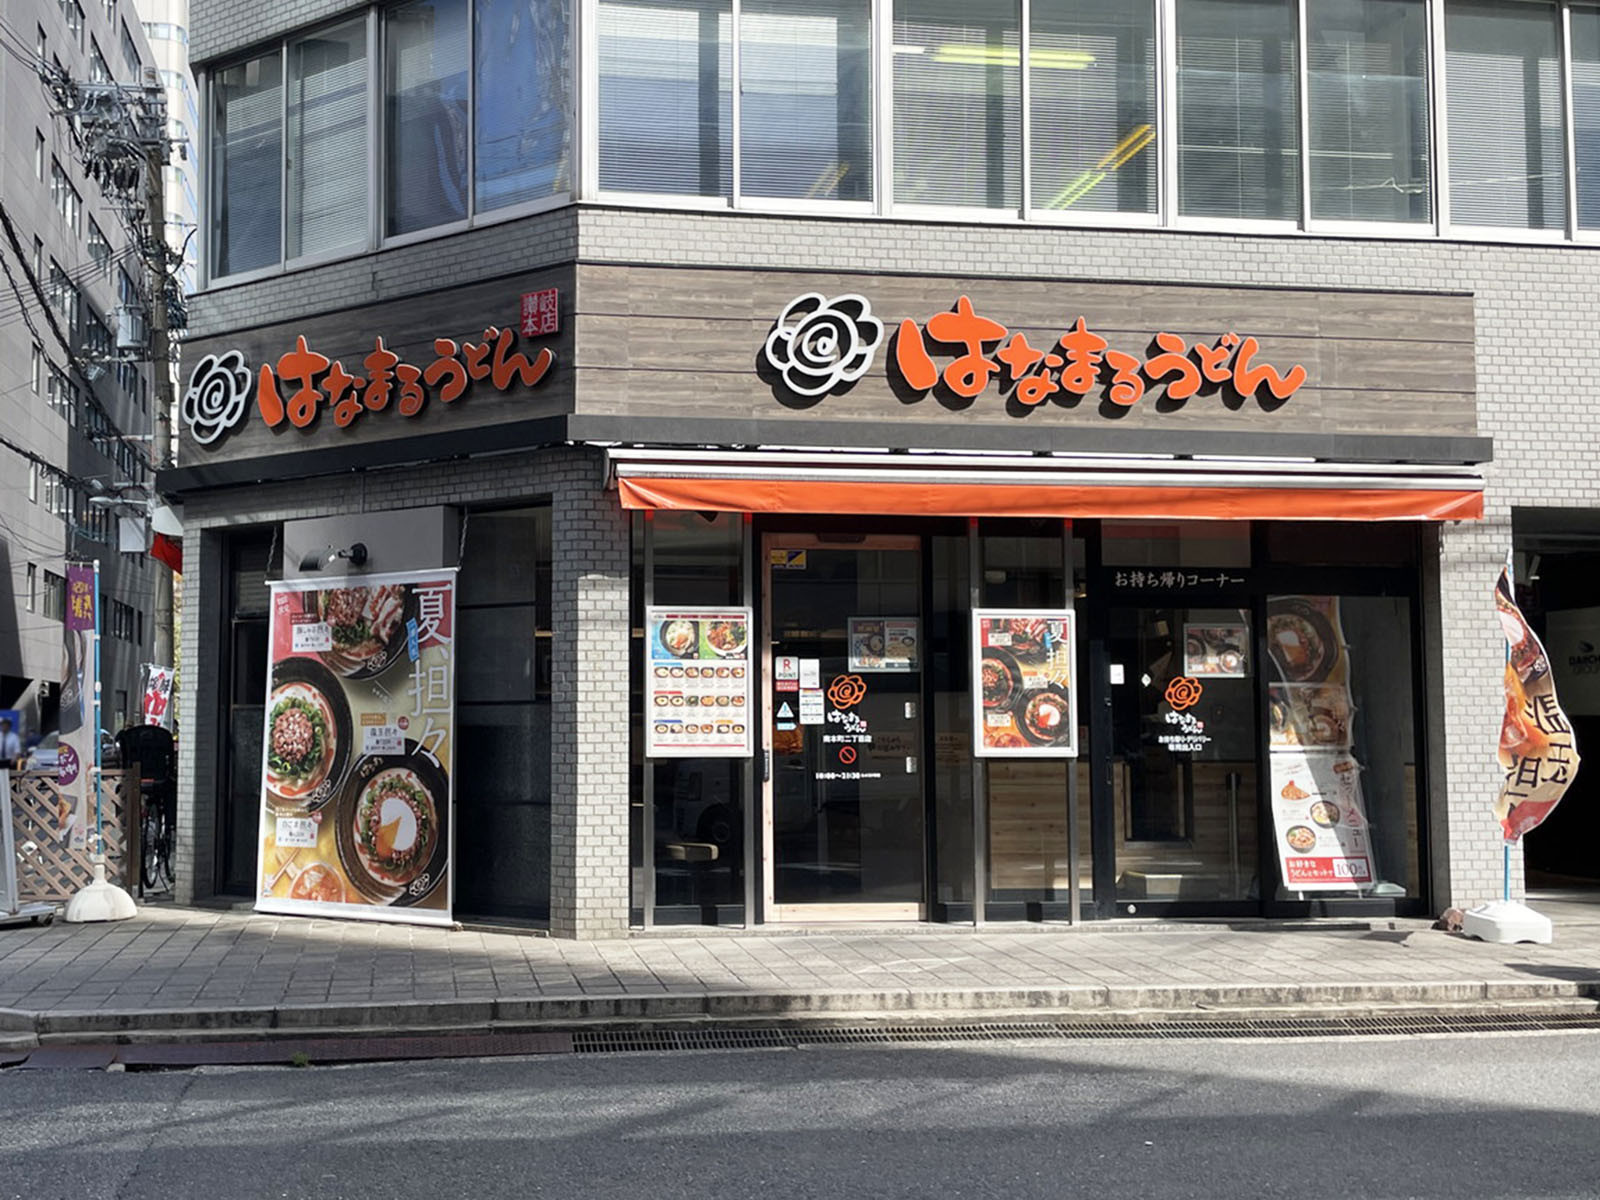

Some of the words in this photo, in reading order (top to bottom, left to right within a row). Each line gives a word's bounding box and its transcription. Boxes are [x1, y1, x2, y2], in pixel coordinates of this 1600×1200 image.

[258, 326, 554, 428] はなまるうどん
[896, 294, 1308, 407] はなまるうどん
[1114, 571, 1246, 588] お持ち帰りコーナー
